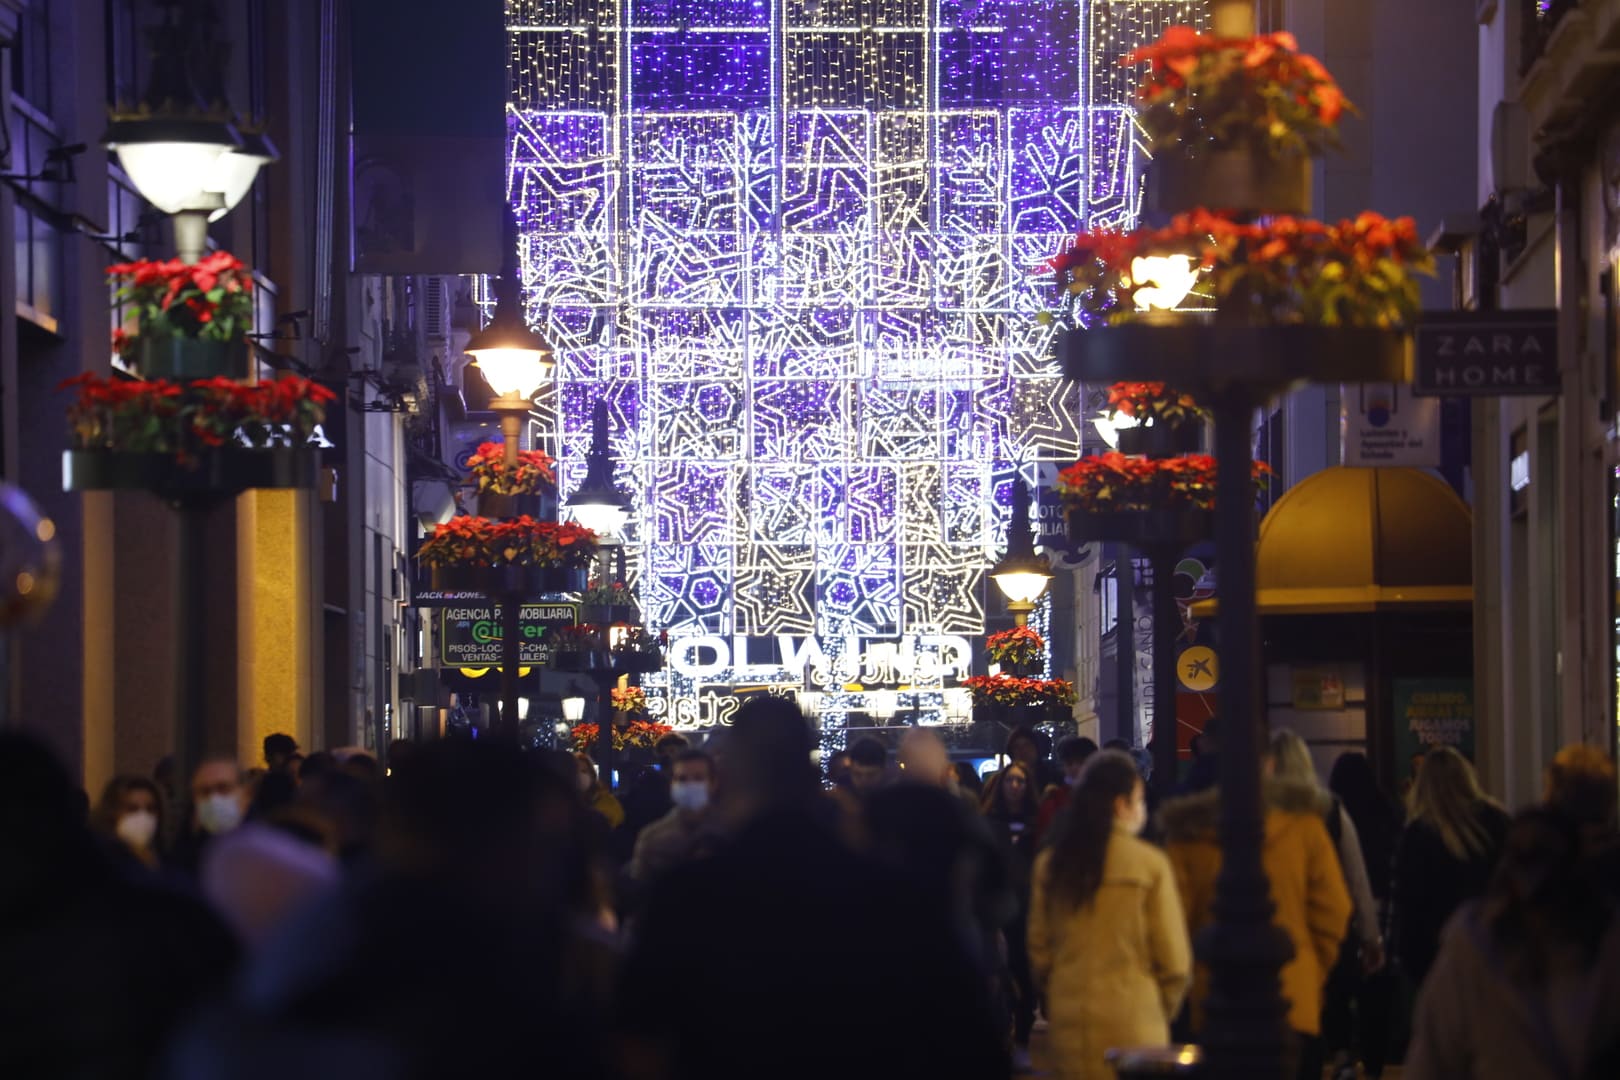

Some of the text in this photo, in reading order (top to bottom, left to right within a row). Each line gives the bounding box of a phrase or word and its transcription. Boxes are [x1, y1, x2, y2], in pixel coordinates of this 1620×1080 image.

[1437, 335, 1542, 356] ZARA
[1435, 366, 1543, 385] HOME
[232, 424, 336, 448] ARA
[446, 608, 491, 620] AGENCIA
